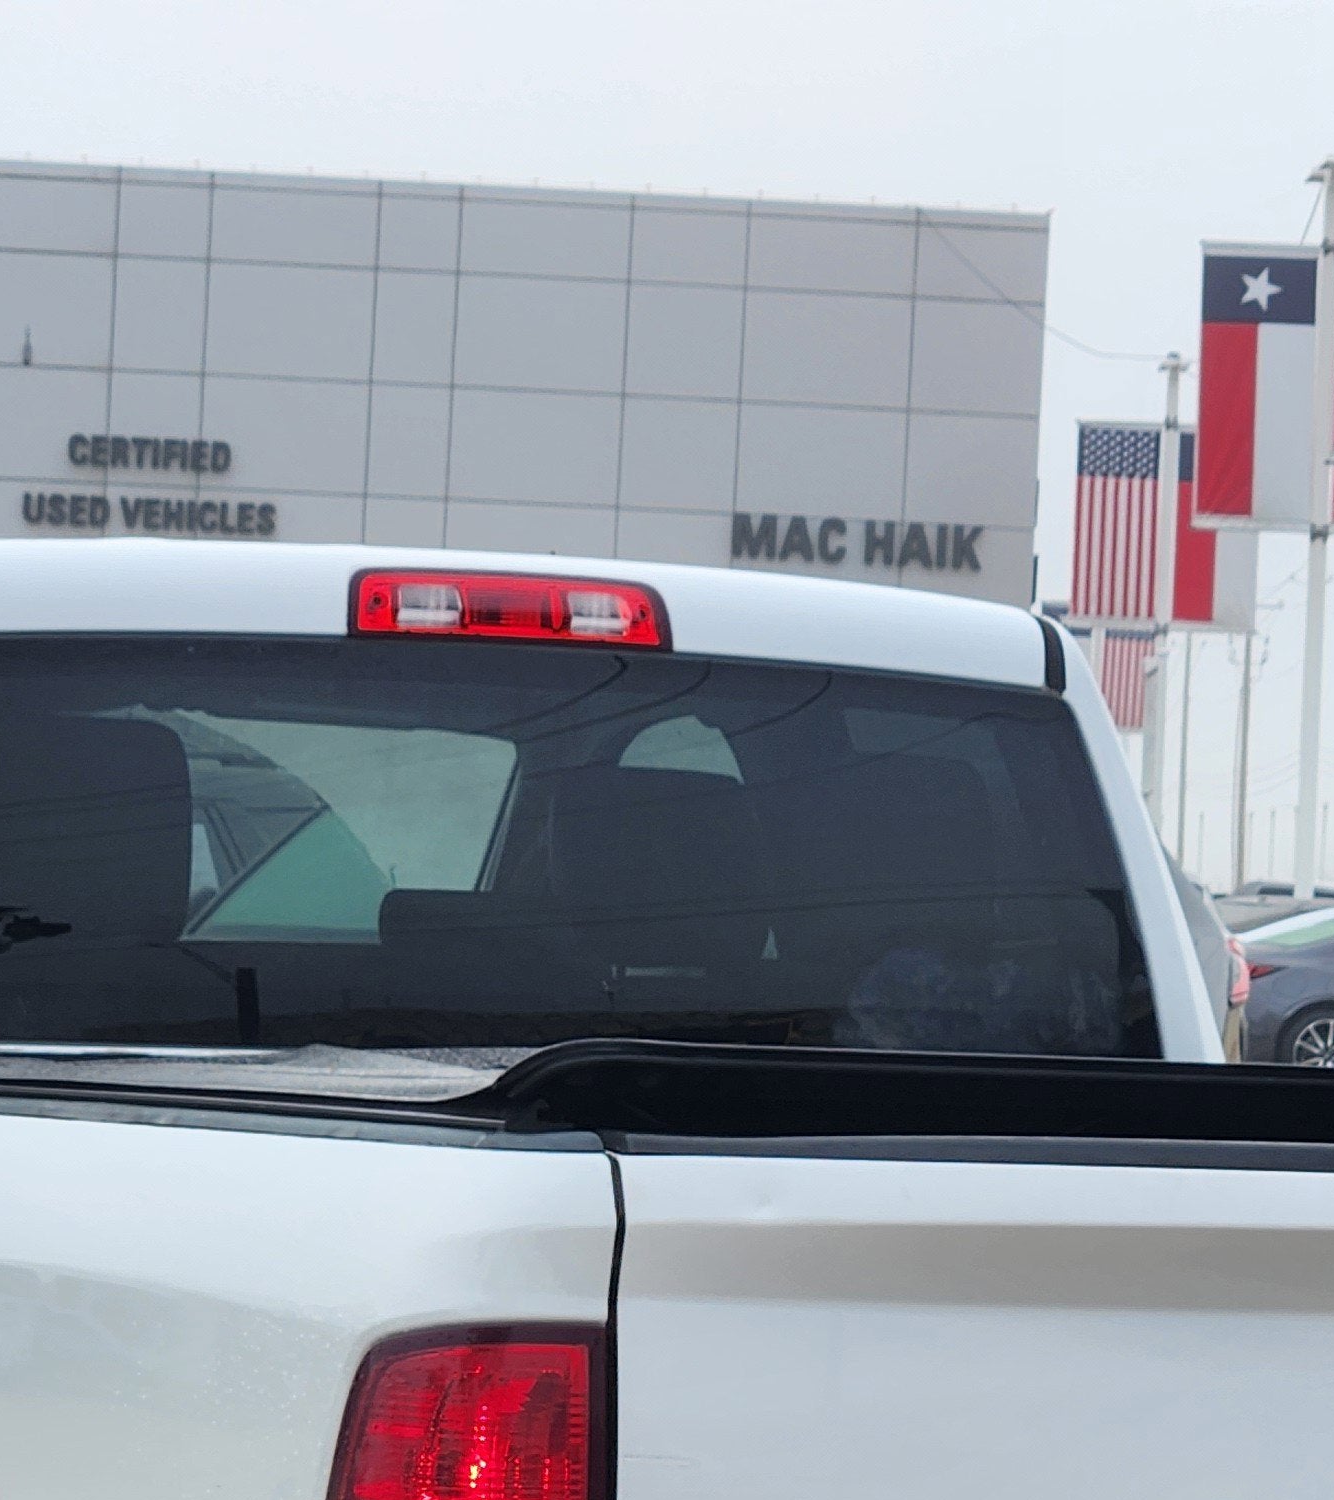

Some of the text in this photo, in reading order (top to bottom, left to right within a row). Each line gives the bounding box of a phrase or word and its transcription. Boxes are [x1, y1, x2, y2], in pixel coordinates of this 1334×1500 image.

[68, 433, 232, 474] CERTIFIED
[22, 490, 277, 535] USED VEHICLES
[730, 512, 985, 573] MAC HAIK
